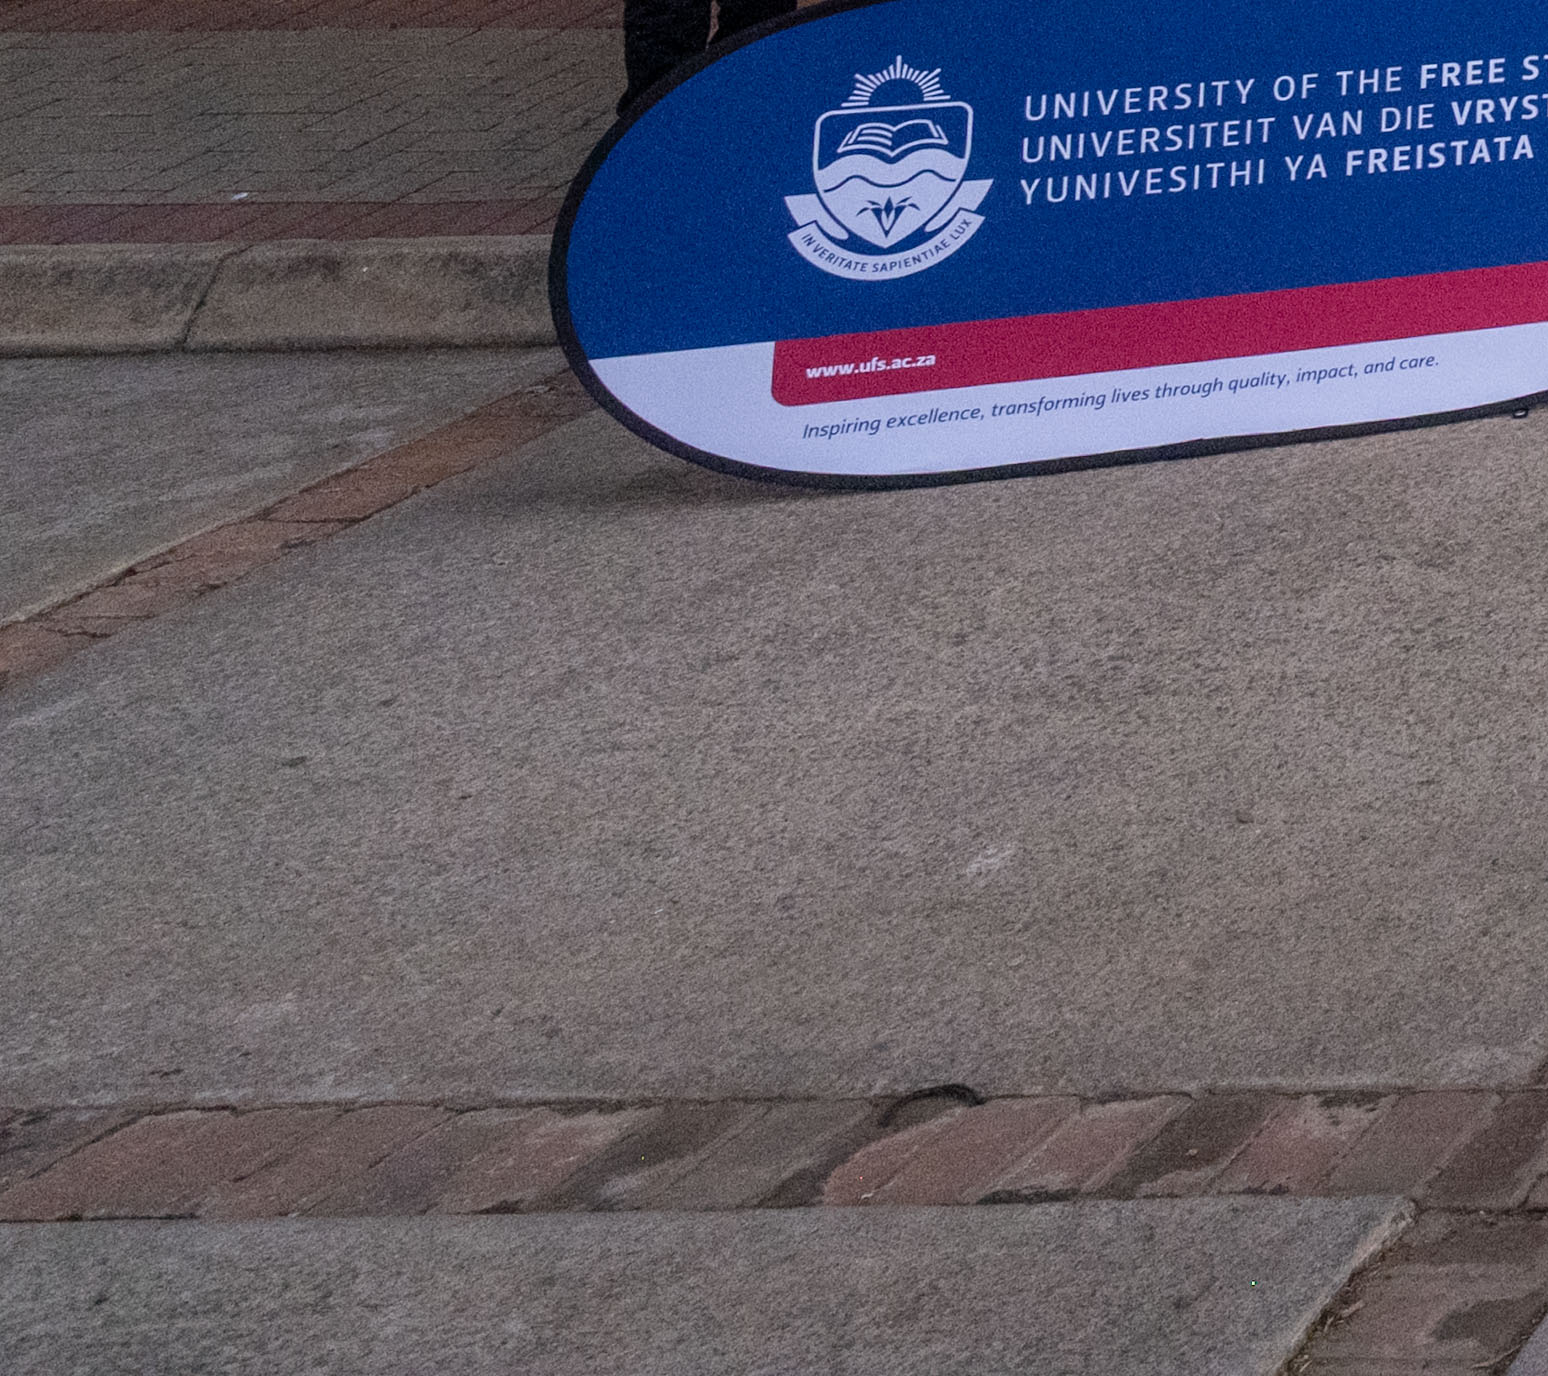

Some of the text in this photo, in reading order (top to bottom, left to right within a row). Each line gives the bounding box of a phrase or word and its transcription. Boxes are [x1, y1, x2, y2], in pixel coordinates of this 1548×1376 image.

[1024, 78, 1256, 121] UNIVERSITY
[1273, 73, 1319, 102] OF
[1336, 66, 1402, 96] THE
[1419, 57, 1506, 89] FREE
[1022, 117, 1276, 163] UNIVERSITEIT
[1292, 110, 1363, 140] VAN
[1380, 103, 1435, 133] DIE
[1020, 134, 1534, 205] YUNIVESITHI YA FREISTATA
[800, 218, 972, 273] IN VERITATE SAPIENTIAE LUX
[802, 354, 1439, 440] Inspiring excellence, transforming lives through quality, impact, and care.
[806, 354, 937, 379] www.ufs.ac.za
